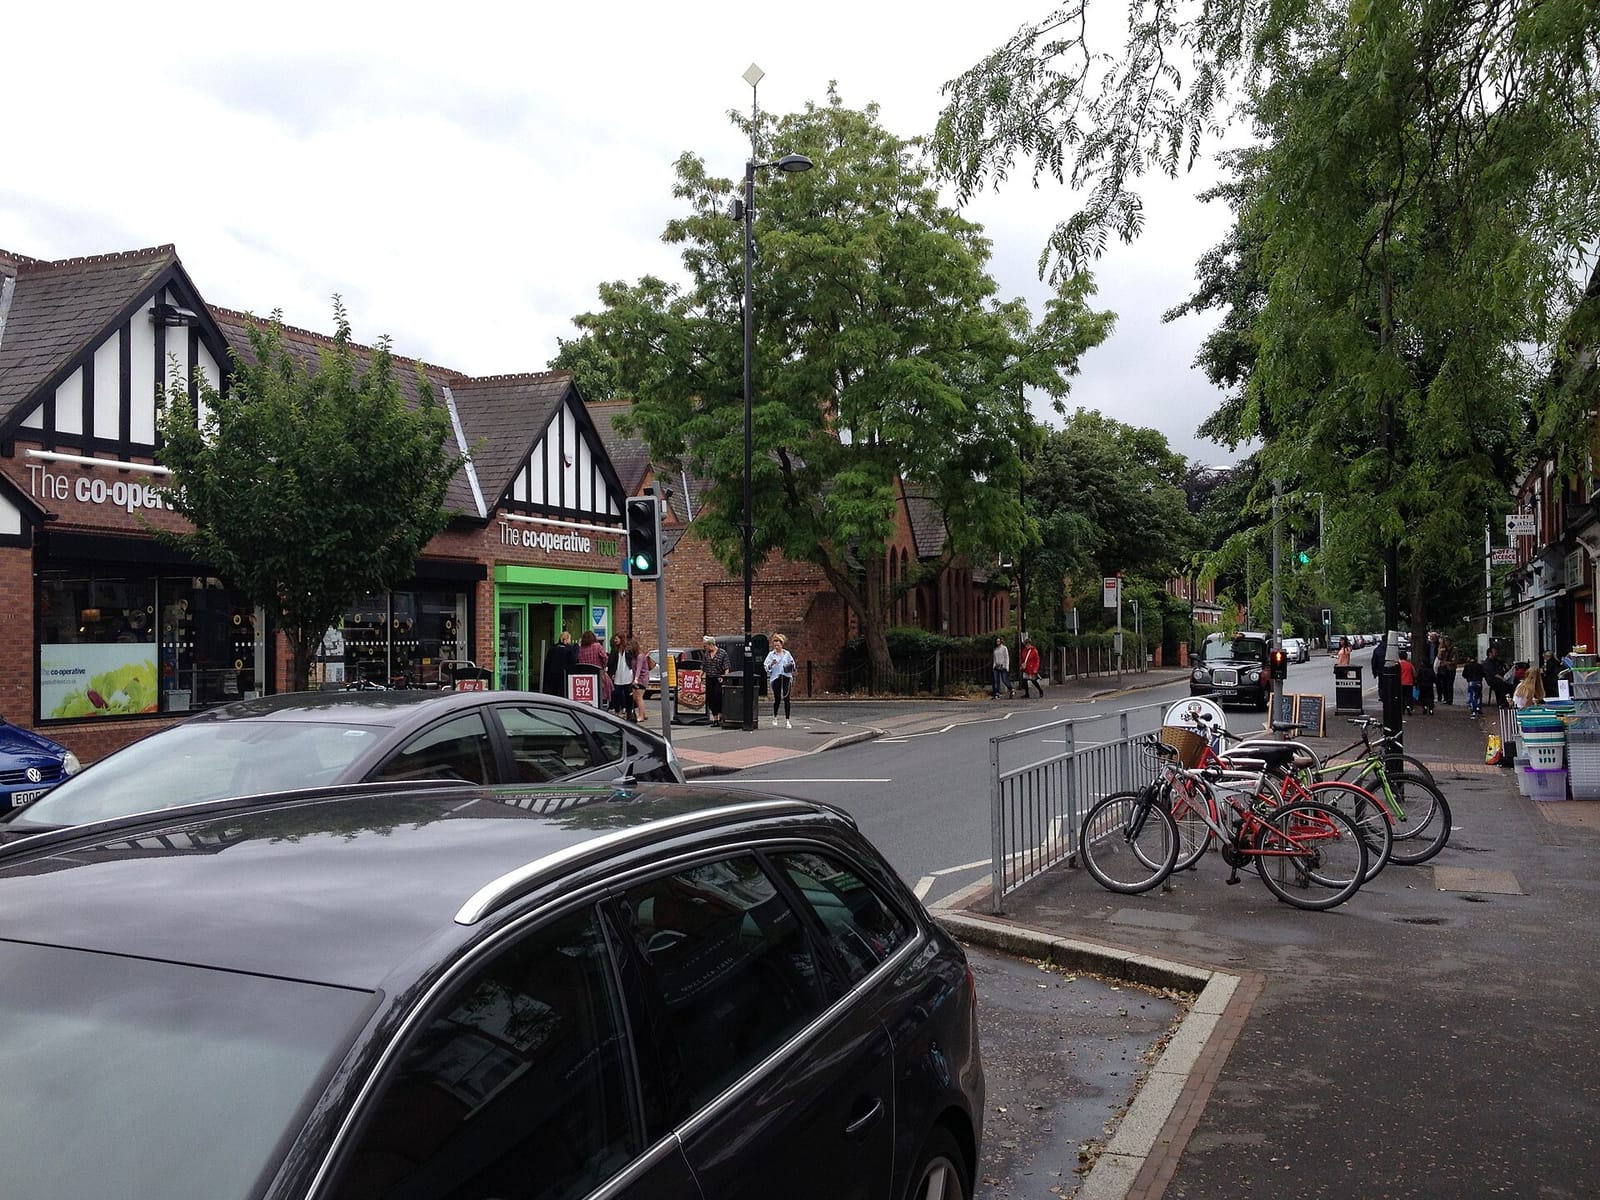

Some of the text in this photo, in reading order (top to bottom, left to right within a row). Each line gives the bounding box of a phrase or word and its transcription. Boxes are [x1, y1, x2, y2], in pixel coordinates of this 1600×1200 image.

[25, 463, 69, 500] The
[498, 521, 519, 546] The
[522, 529, 591, 553] co-operative
[50, 668, 86, 676] co-operative
[463, 682, 474, 691] Any
[575, 678, 590, 688] Only
[575, 687, 590, 697] £12
